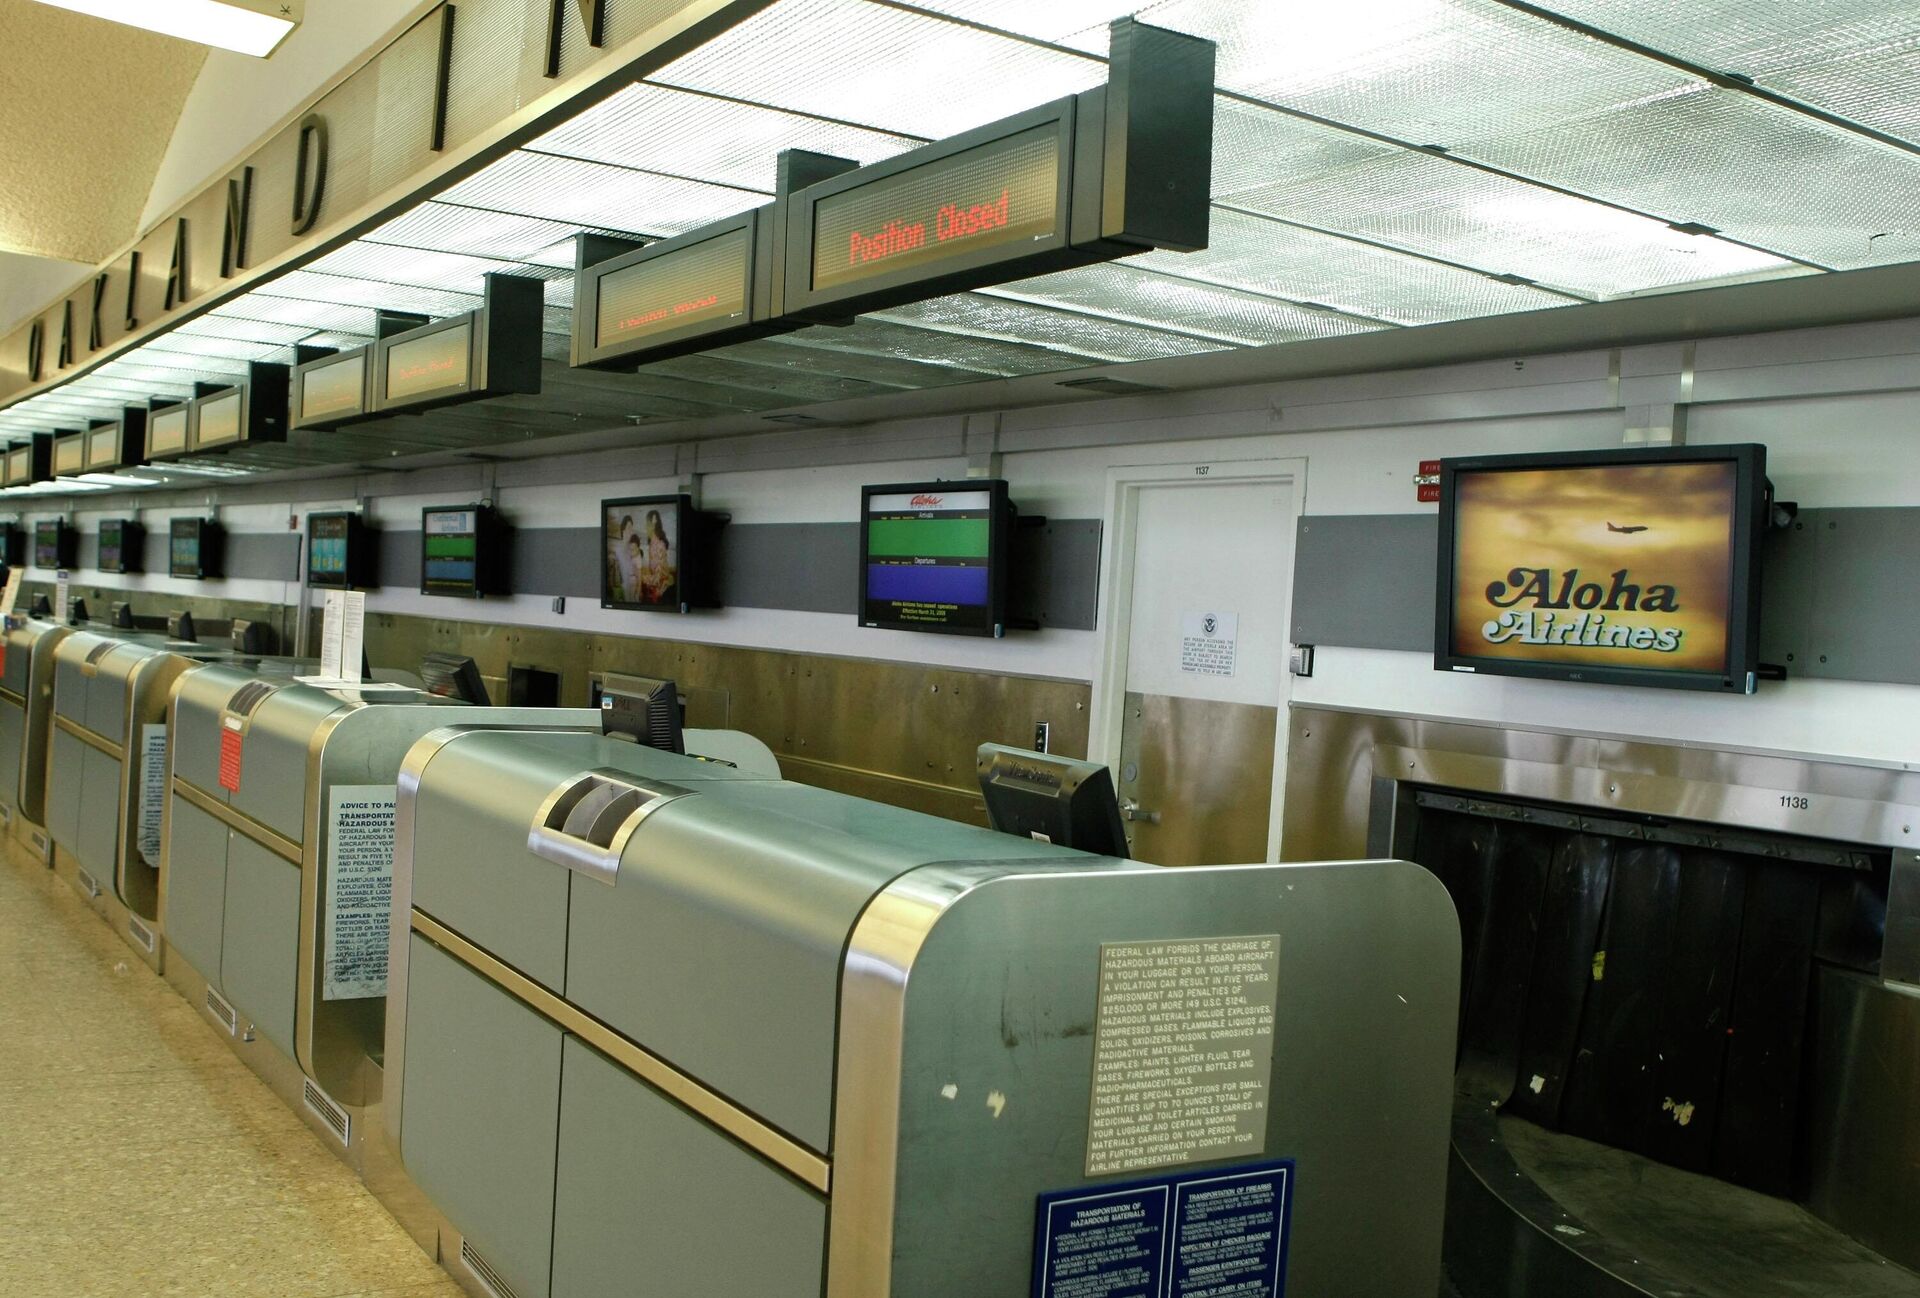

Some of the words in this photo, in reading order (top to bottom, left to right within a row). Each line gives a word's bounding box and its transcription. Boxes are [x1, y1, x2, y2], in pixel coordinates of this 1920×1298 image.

[848, 217, 927, 265] Position
[935, 187, 1009, 242] Closed
[28, 113, 329, 382] OAKLAND
[1195, 466, 1210, 475] 1137
[1484, 566, 1680, 613] Aloha
[1481, 610, 1683, 653] Airlines
[1780, 795, 1809, 810] 1138
[1106, 947, 1142, 957] FEDERAL
[1146, 946, 1163, 955] LAW
[1166, 944, 1200, 954] FORBIDS
[1203, 943, 1218, 952] THE
[1221, 941, 1258, 951] CARRIAGE
[1261, 940, 1270, 948] OF
[1105, 958, 1153, 969] HAZARDOUS
[1157, 955, 1201, 966] MATERIALS
[1205, 953, 1235, 963] ABOARD
[1237, 951, 1273, 960] AIRCRAFT
[1104, 971, 1113, 980] IN
[1117, 970, 1138, 979] YOUR
[1142, 967, 1177, 977] LUGGAGE
[1181, 966, 1192, 975] OR
[1194, 965, 1206, 974] ON
[1209, 964, 1229, 973] YOUR
[1104, 983, 1110, 992] A
[1114, 980, 1156, 991] VIOLATION
[1159, 979, 1176, 988] CAN
[1178, 976, 1209, 986] RESULT
[1212, 975, 1221, 984] IN
[1223, 974, 1241, 983] FIVE
[1244, 972, 1268, 981] YEARS
[1103, 990, 1163, 1003] IMPRISONMENT
[1167, 989, 1184, 998] AND
[1186, 986, 1229, 997] PENALTIES
[1231, 985, 1241, 993] OF
[1146, 1002, 1157, 1011] OR
[1160, 1000, 1182, 1010] MORE
[1100, 1025, 1151, 1037] COMPRESSED
[1182, 1019, 1225, 1030] FLAMMABLE
[1228, 1016, 1256, 1026] LIQUIDS
[1258, 1015, 1273, 1024] AND
[1101, 1014, 1146, 1026] HAZARDOUS
[1149, 1011, 1191, 1022] MATERIALS
[1194, 1008, 1224, 1018] INCLUDE
[1210, 1027, 1254, 1038] CORROSIVES
[1256, 1025, 1271, 1034] AND
[1098, 1047, 1148, 1060] RADIOACTIVE
[1173, 1053, 1204, 1064] LIGHTER
[1232, 1049, 1250, 1058] TEAR
[1173, 1064, 1202, 1075] OXYGEN
[1205, 1061, 1237, 1071] BOTTLES
[1239, 1059, 1253, 1068] AND
[1096, 1094, 1120, 1105] THERE
[1124, 1092, 1138, 1102] ARE
[1142, 1089, 1172, 1100] SPECIAL
[1175, 1083, 1219, 1096] EXCEPTIONS
[1222, 1082, 1236, 1091] FOR
[1239, 1079, 1262, 1089] SMALL
[1094, 1103, 1140, 1116] QUANTITIES
[1158, 1100, 1168, 1109] TO
[1183, 1095, 1212, 1106] OUNCES
[1242, 1090, 1251, 1099] OF
[1093, 1115, 1134, 1127] MEDICINAL
[1138, 1113, 1153, 1122] AND
[1156, 1109, 1182, 1120] TOILET
[1185, 1105, 1219, 1117] ARTICLES
[1222, 1101, 1252, 1112] CARRIED
[1255, 1100, 1263, 1108] IN
[1093, 1128, 1113, 1138] YOUR
[1116, 1124, 1149, 1136] LUGGAGE
[1153, 1121, 1168, 1131] AND
[1170, 1117, 1202, 1129] CERTAIN
[1091, 1136, 1135, 1150] MATERIALS
[1137, 1132, 1169, 1144] CARRIED
[1172, 1130, 1182, 1139] ON
[1186, 1128, 1205, 1138] YOUR
[1091, 1151, 1106, 1161] FOR
[1109, 1146, 1143, 1158] FURTHER
[1147, 1139, 1196, 1153] INFORMATION
[1198, 1135, 1230, 1147] CONTACT
[1234, 1132, 1252, 1142] YOUR
[1090, 1160, 1120, 1172] AIRLINE
[1070, 1215, 1110, 1228] HAZARDOUS
[1111, 1209, 1146, 1221] MATERIALS
[1076, 1204, 1131, 1219] TRANSPORTATION
[1132, 1201, 1142, 1210] OF
